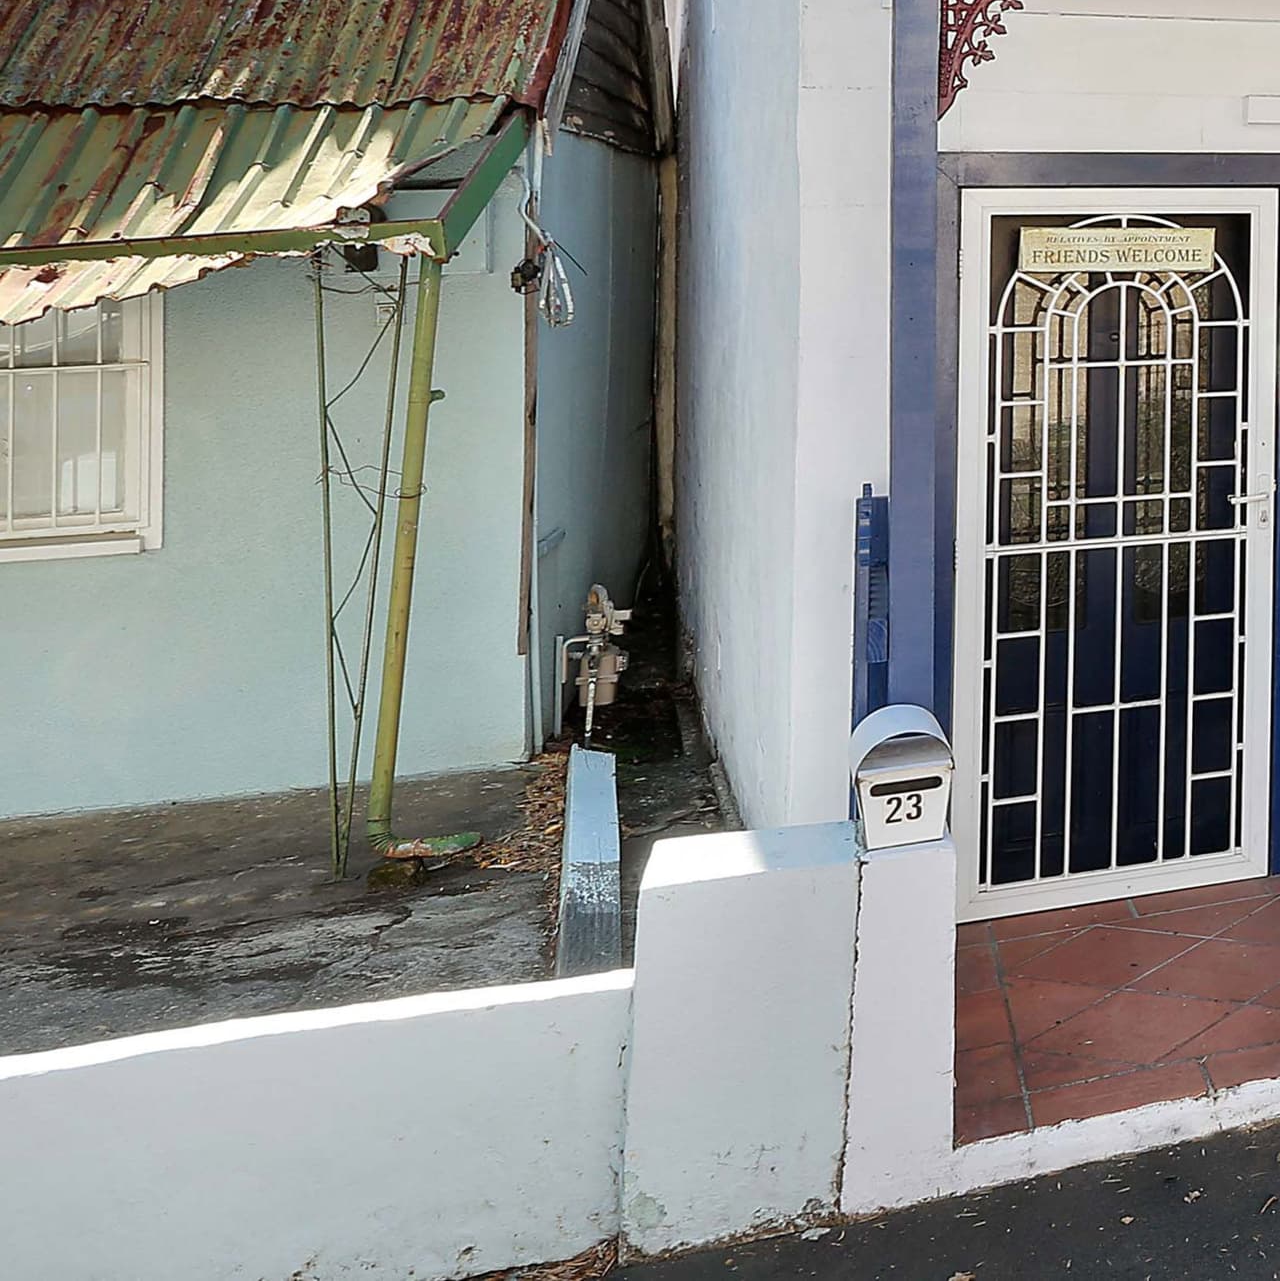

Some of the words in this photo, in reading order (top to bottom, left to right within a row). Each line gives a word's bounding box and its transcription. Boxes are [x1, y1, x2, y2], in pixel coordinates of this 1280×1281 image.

[1032, 248, 1111, 265] FRIENDS
[1116, 247, 1203, 263] WELCOME
[884, 793, 924, 825] 23
